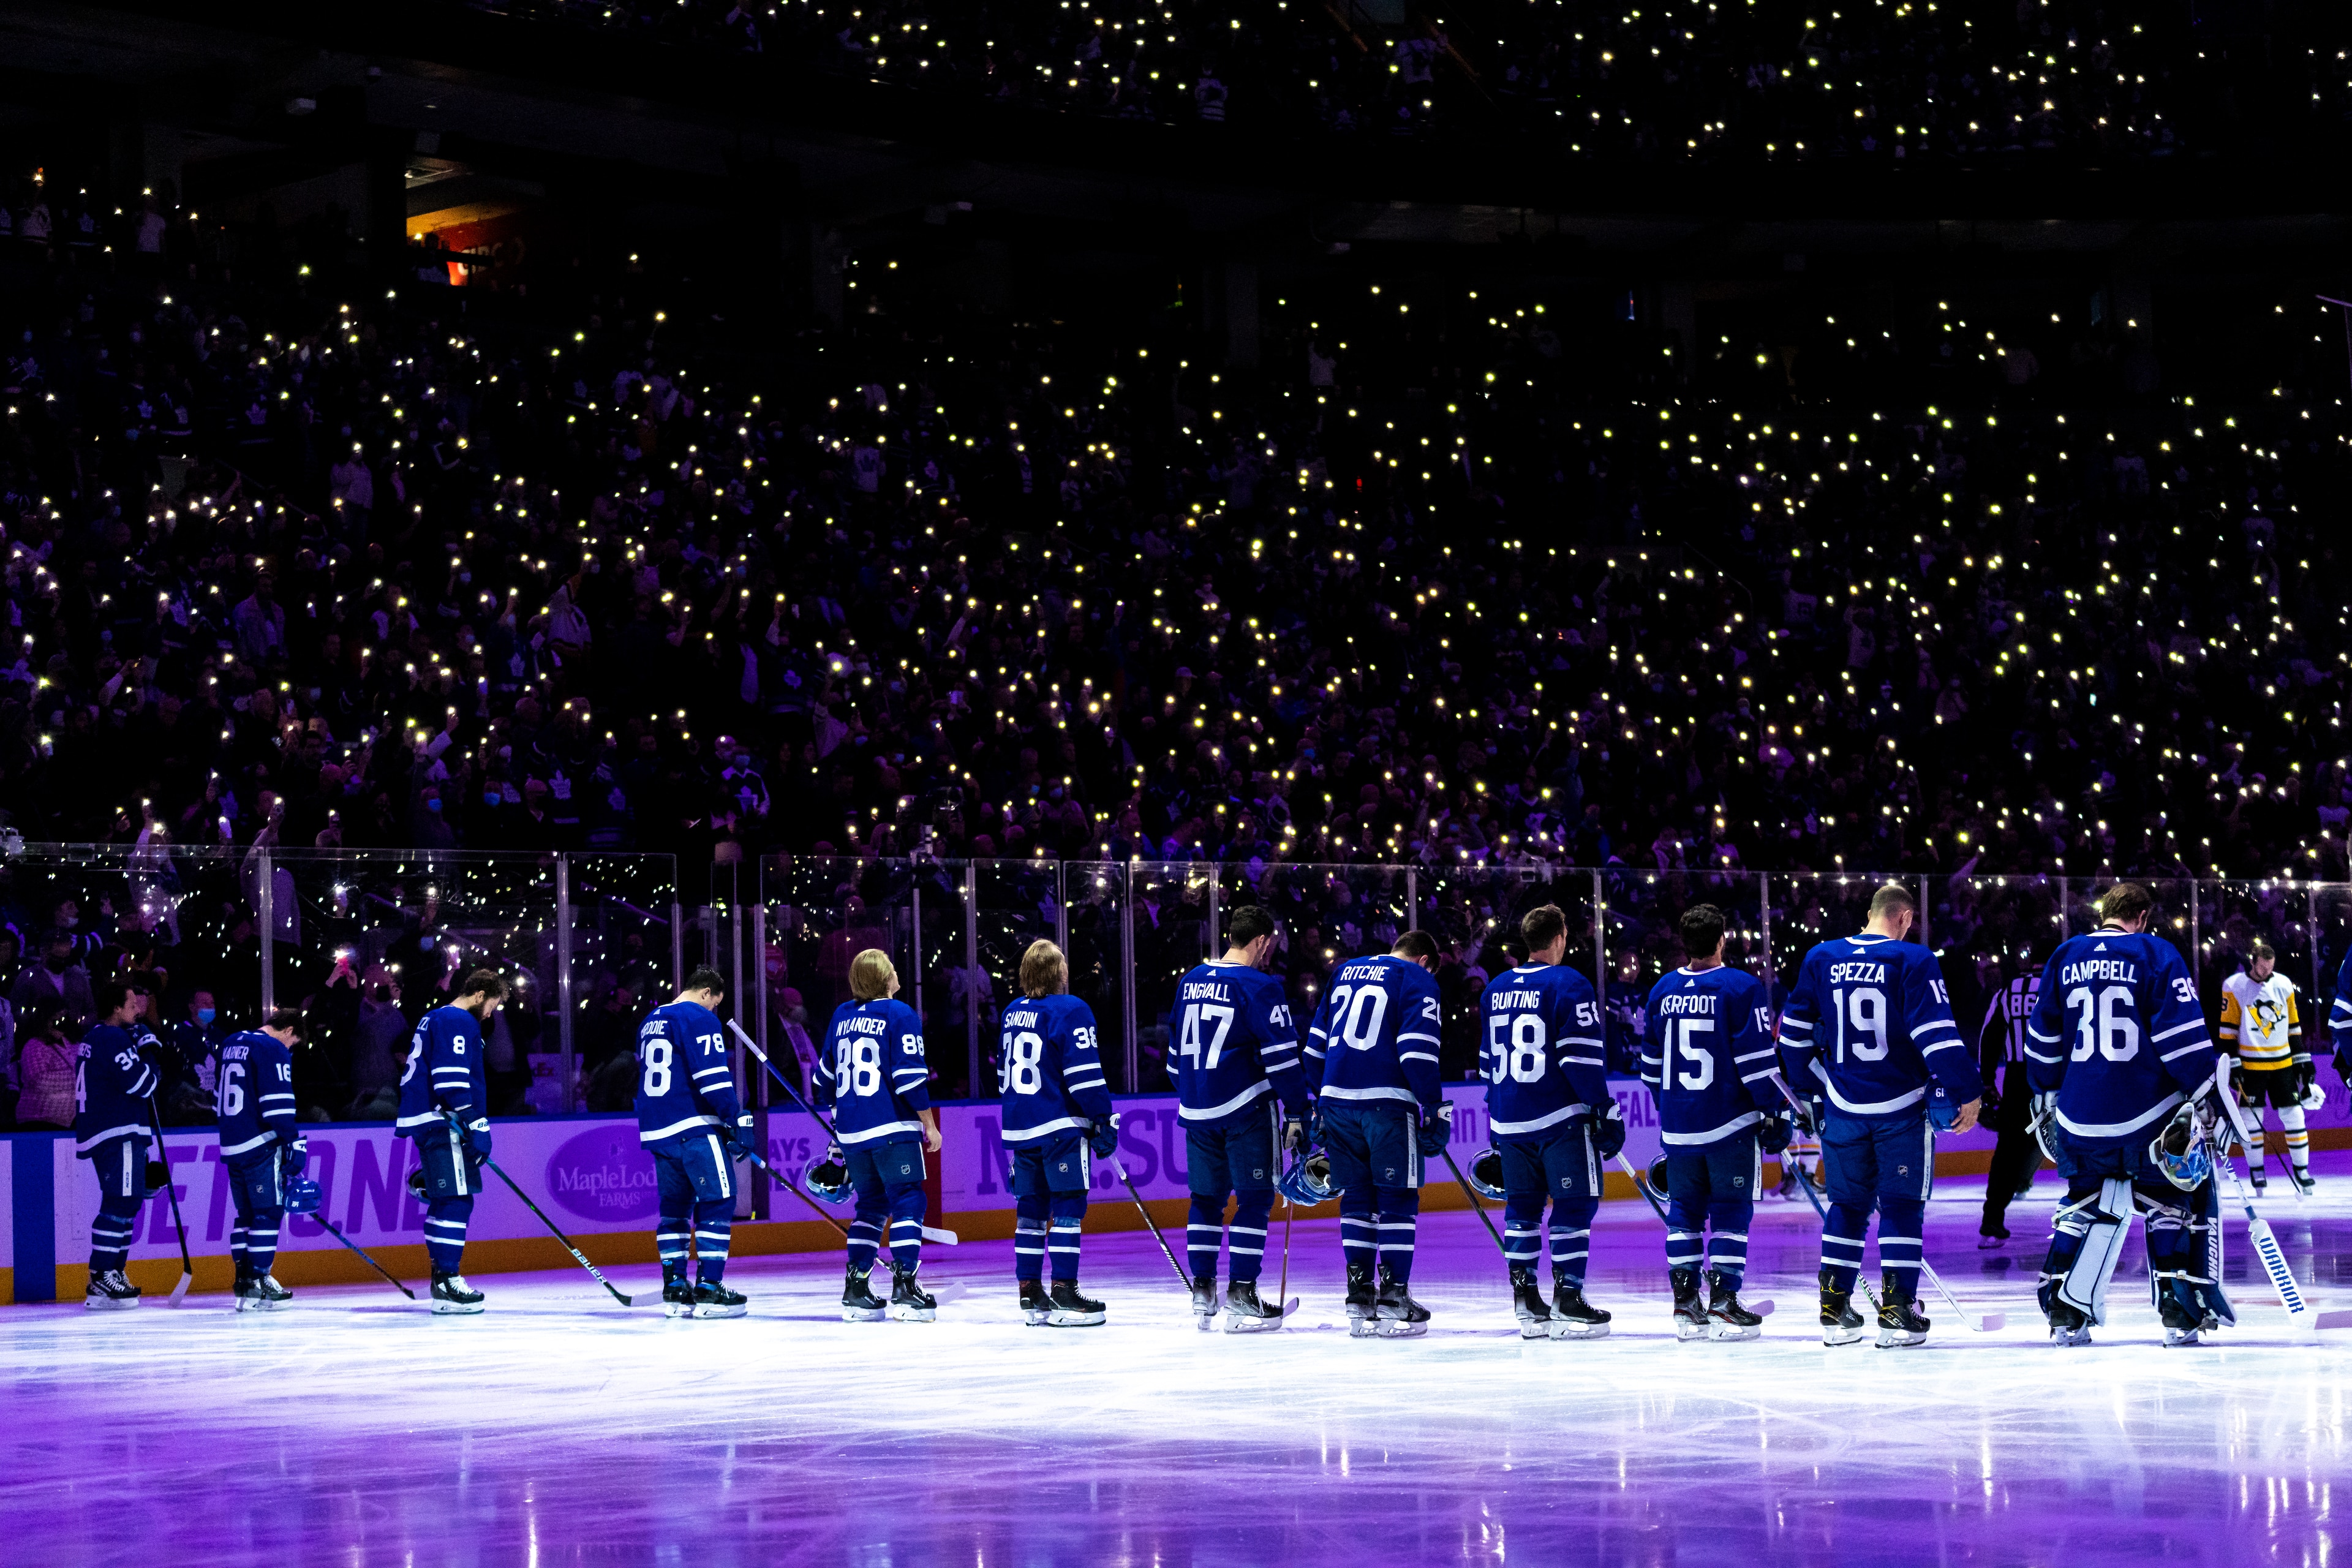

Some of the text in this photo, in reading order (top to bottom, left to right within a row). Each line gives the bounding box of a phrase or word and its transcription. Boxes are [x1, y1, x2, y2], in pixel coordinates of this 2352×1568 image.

[1340, 965, 1390, 982] RITCHIE
[1830, 962, 1885, 984] SPEZZA
[2062, 960, 2138, 985] CAMPBELL
[1183, 982, 1231, 1003] ENGVALL
[1491, 990, 1540, 1011] BUNTING
[1269, 1005, 1292, 1028] 47
[1327, 984, 1389, 1051] 20
[1660, 994, 1717, 1017] KERFOOT
[835, 1017, 886, 1036] NYLANDER
[1004, 1011, 1039, 1029] SANDIN
[1755, 1006, 1771, 1033] 15
[1833, 987, 1889, 1063] 19
[2067, 986, 2139, 1062] 36
[453, 1035, 466, 1055] 8
[696, 1033, 725, 1056] 78
[902, 1033, 925, 1057] 88
[1072, 1026, 1098, 1049] 38
[1180, 1003, 1235, 1070] 47
[115, 1045, 140, 1071] 34
[1489, 1014, 1546, 1085] 58
[1662, 1018, 1715, 1091] 15
[276, 1063, 292, 1082] 16
[639, 1036, 673, 1097] 8
[835, 1036, 881, 1099] 88
[2207, 1216, 2218, 1282] VAUGHN
[571, 1248, 608, 1284] BAUER
[2260, 1237, 2304, 1314] WARRIOR
[1884, 1312, 1905, 1328] CCM
